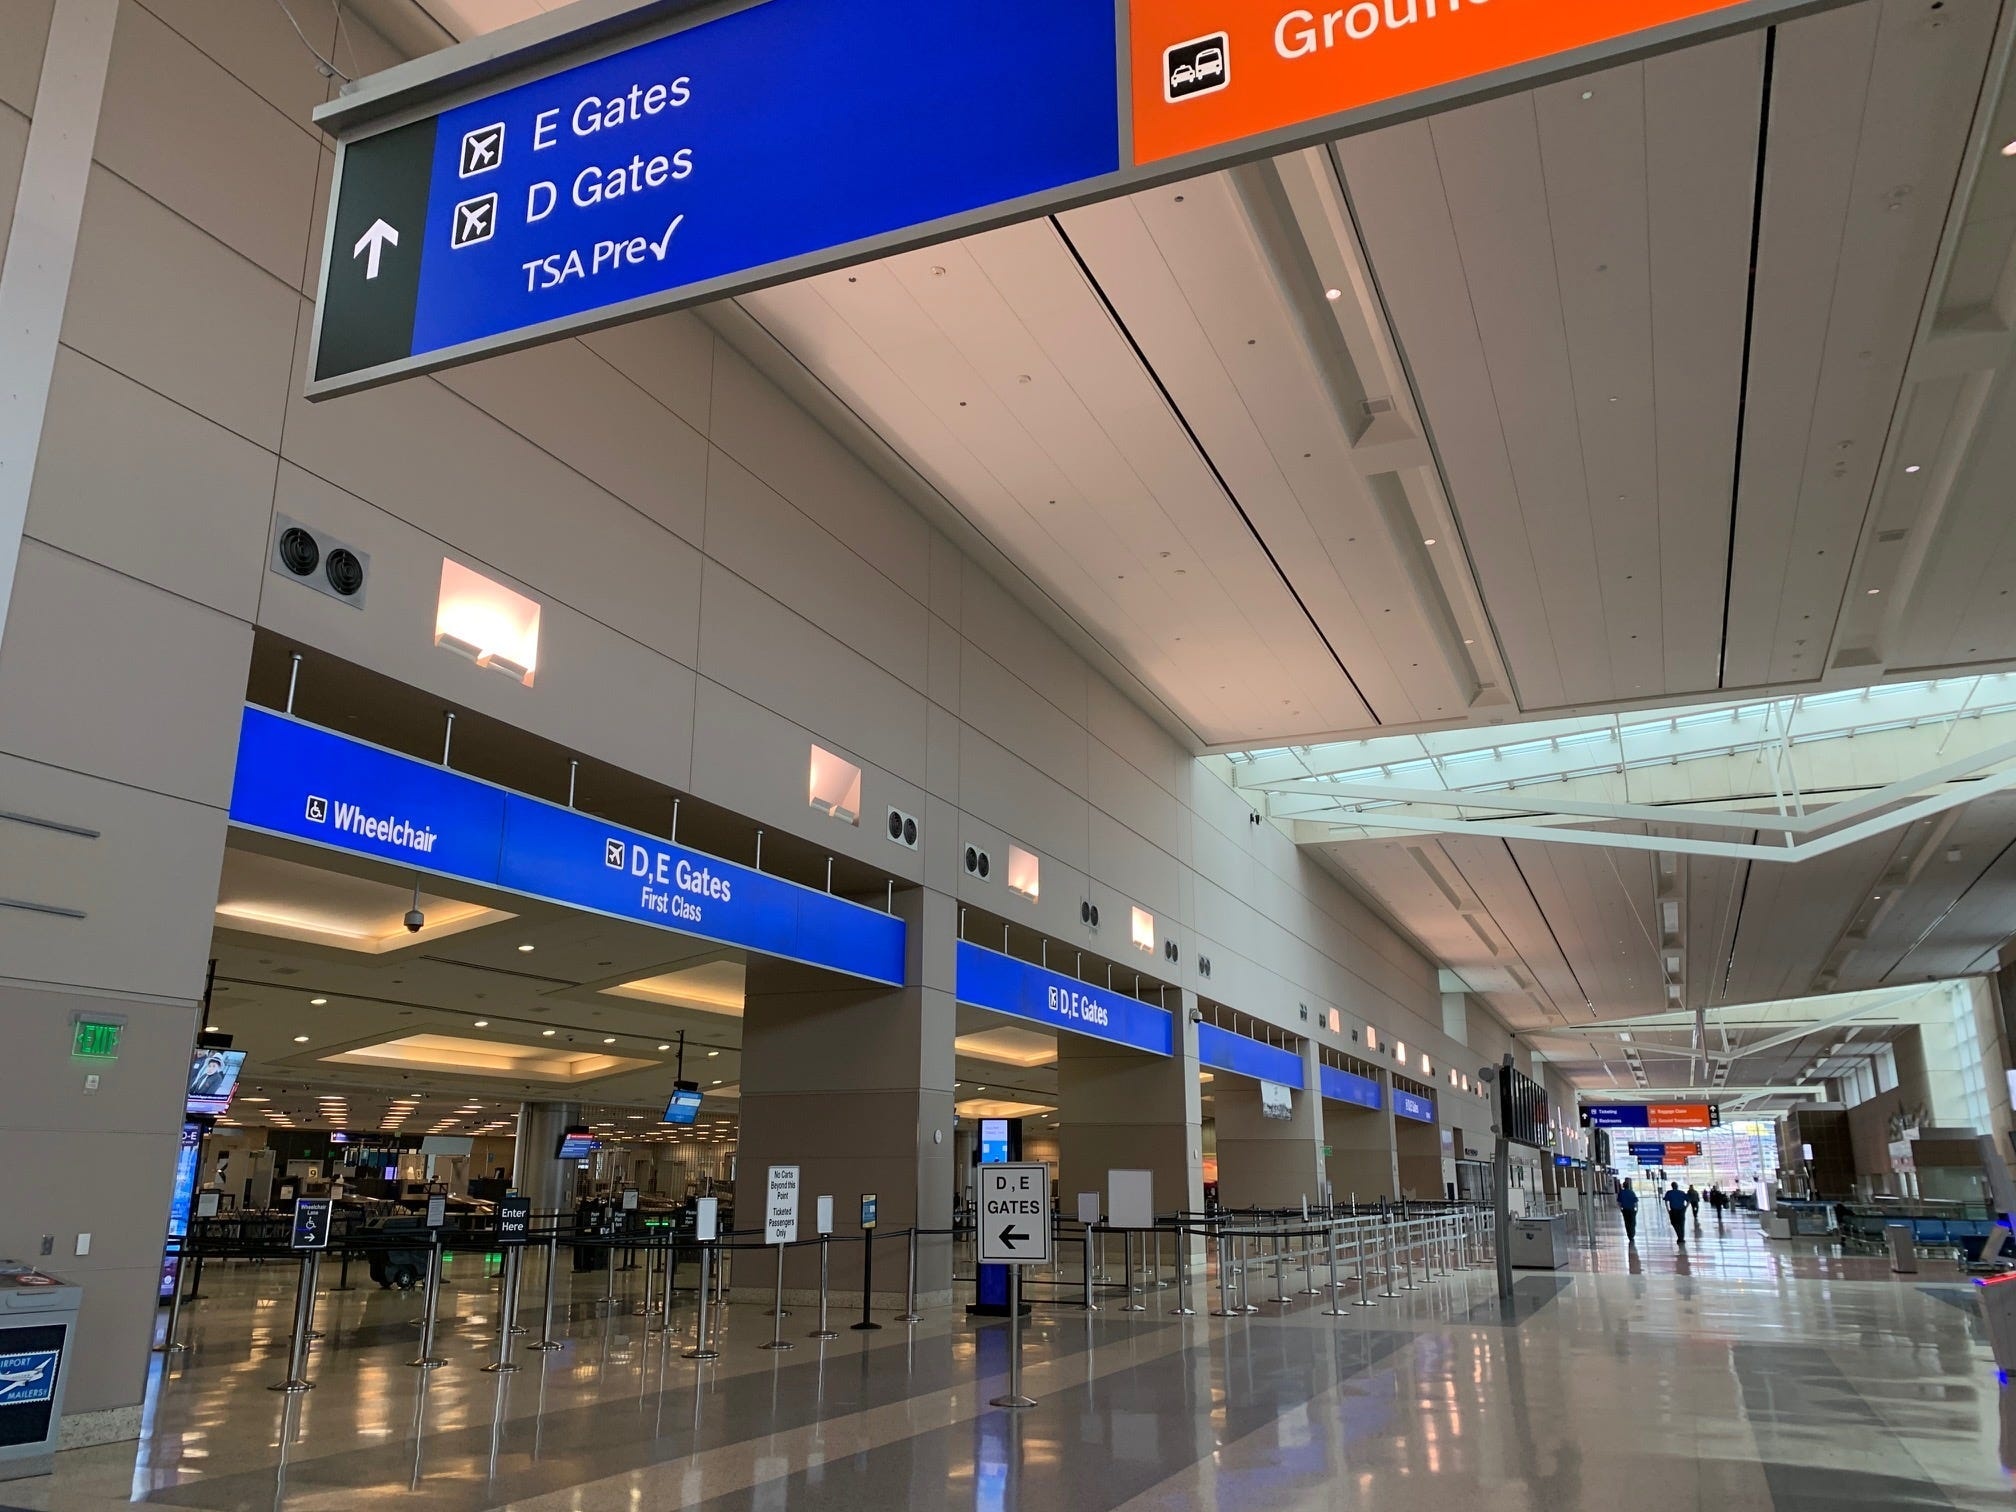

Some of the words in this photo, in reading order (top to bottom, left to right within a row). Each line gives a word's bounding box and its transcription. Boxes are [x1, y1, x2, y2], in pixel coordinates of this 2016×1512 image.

[1274, 0, 1489, 59] Grou
[533, 107, 560, 151] E
[572, 76, 691, 136] Gates
[526, 181, 557, 223] D
[572, 148, 693, 207] Gates
[522, 249, 586, 292] TSA
[334, 800, 438, 852] Wheelchair
[631, 844, 671, 885] D,E
[676, 860, 731, 902] Gates
[641, 886, 669, 914] First
[671, 894, 702, 922] Class
[1060, 988, 1080, 1020] D,E
[1081, 995, 1108, 1027] Gates
[781, 1170, 794, 1179] Carts
[770, 1181, 788, 1191] Beyond
[788, 1181, 796, 1189] this
[777, 1192, 789, 1200] Point
[501, 1208, 527, 1218] Enter
[773, 1207, 792, 1216] Ticketed
[987, 1200, 1041, 1215] GATES
[501, 1221, 524, 1231] Here
[768, 1218, 795, 1229] Passengers
[776, 1229, 787, 1239] Only
